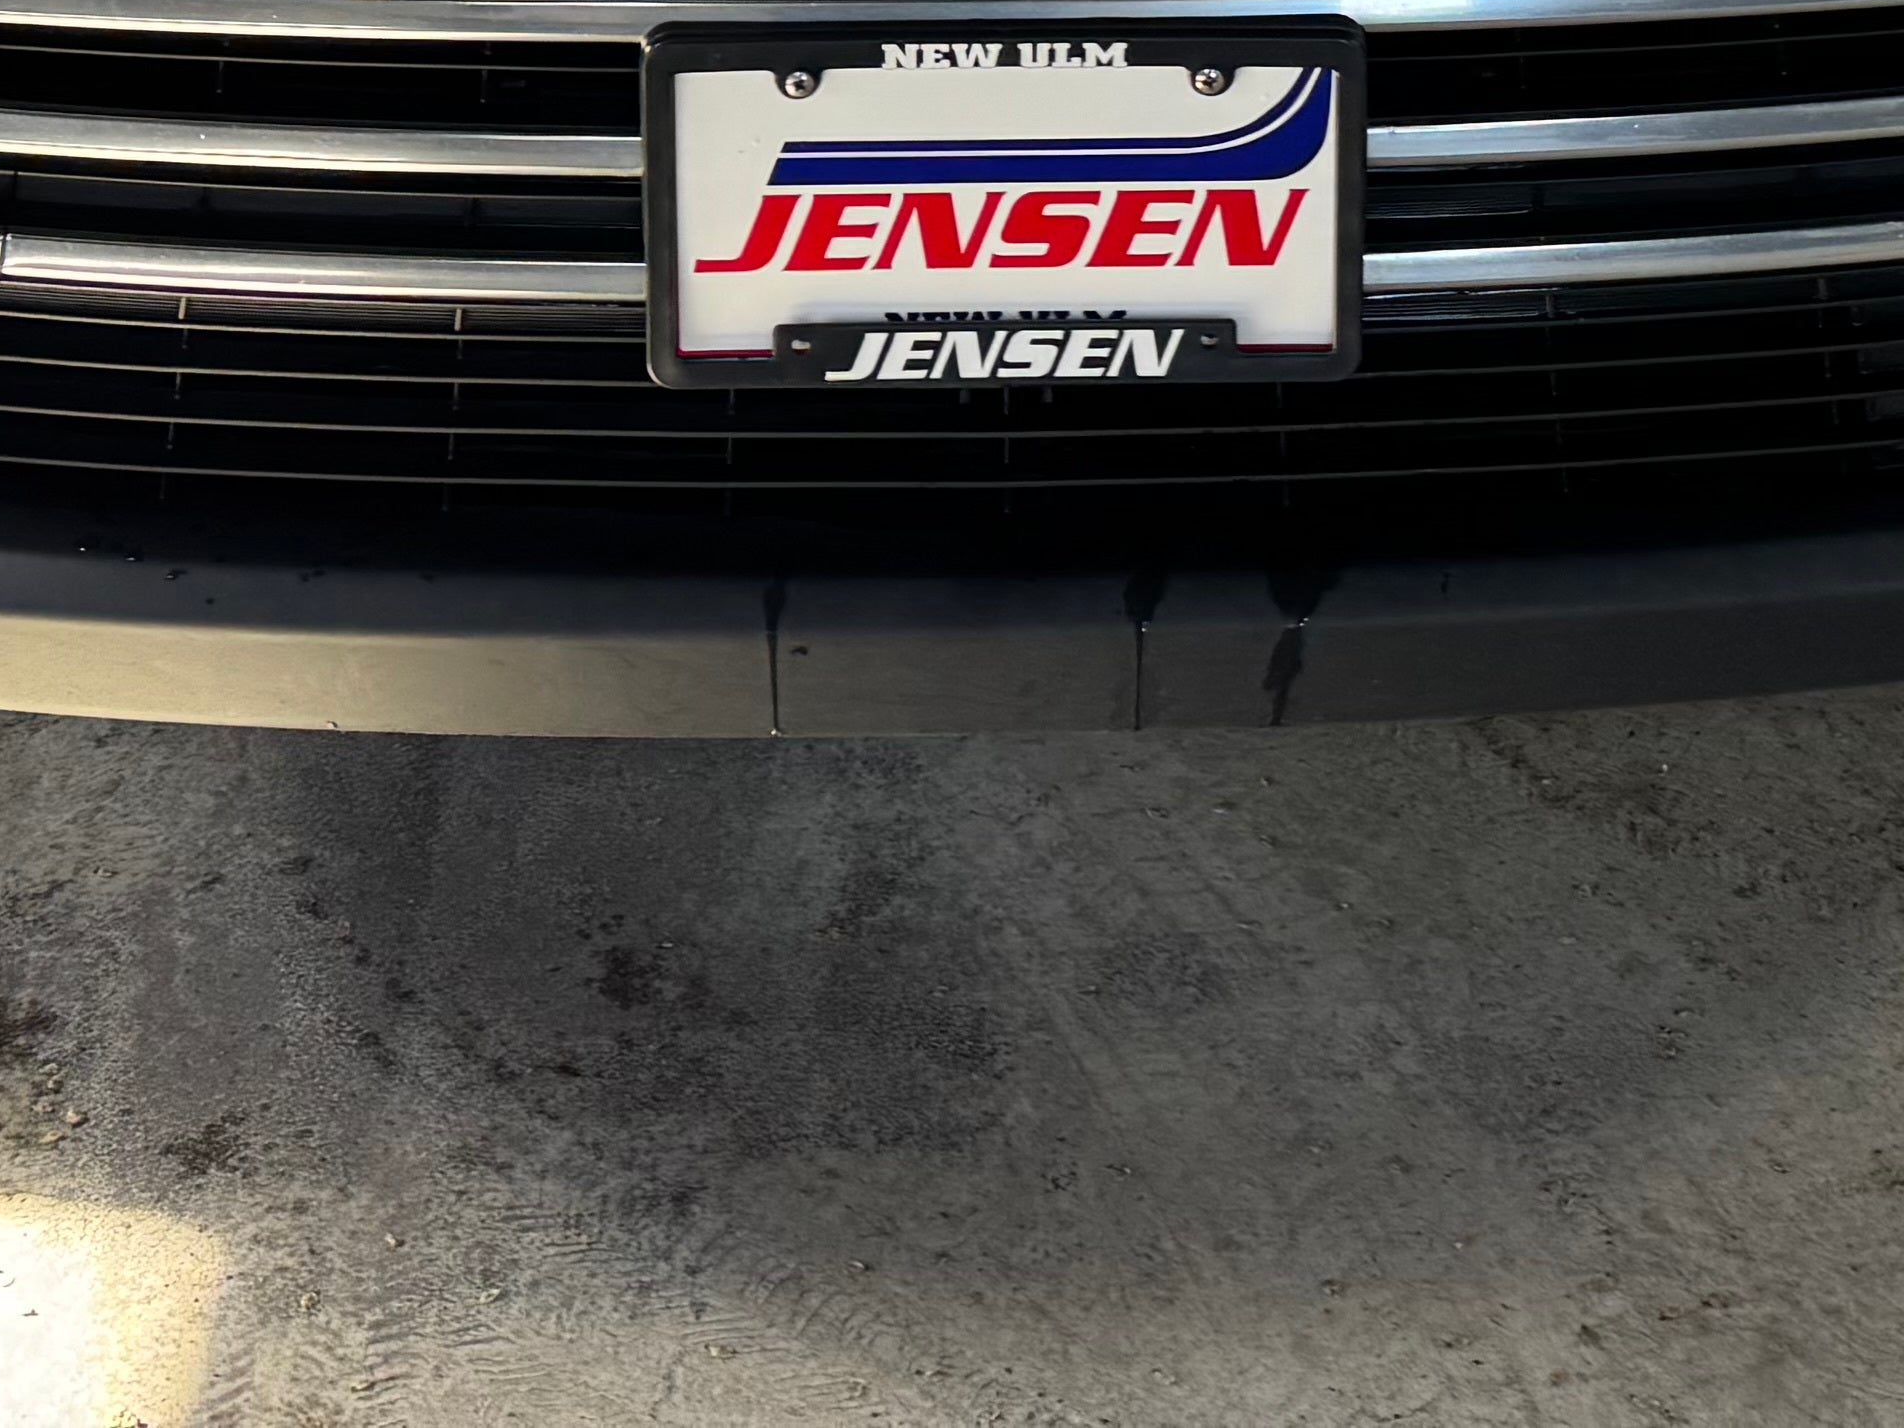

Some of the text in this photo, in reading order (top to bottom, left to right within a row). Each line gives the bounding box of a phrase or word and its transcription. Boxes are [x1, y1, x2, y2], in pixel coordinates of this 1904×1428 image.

[881, 42, 1129, 69] NEW ULM
[694, 189, 1308, 272] JENSEN
[824, 328, 1185, 382] JENSEN
